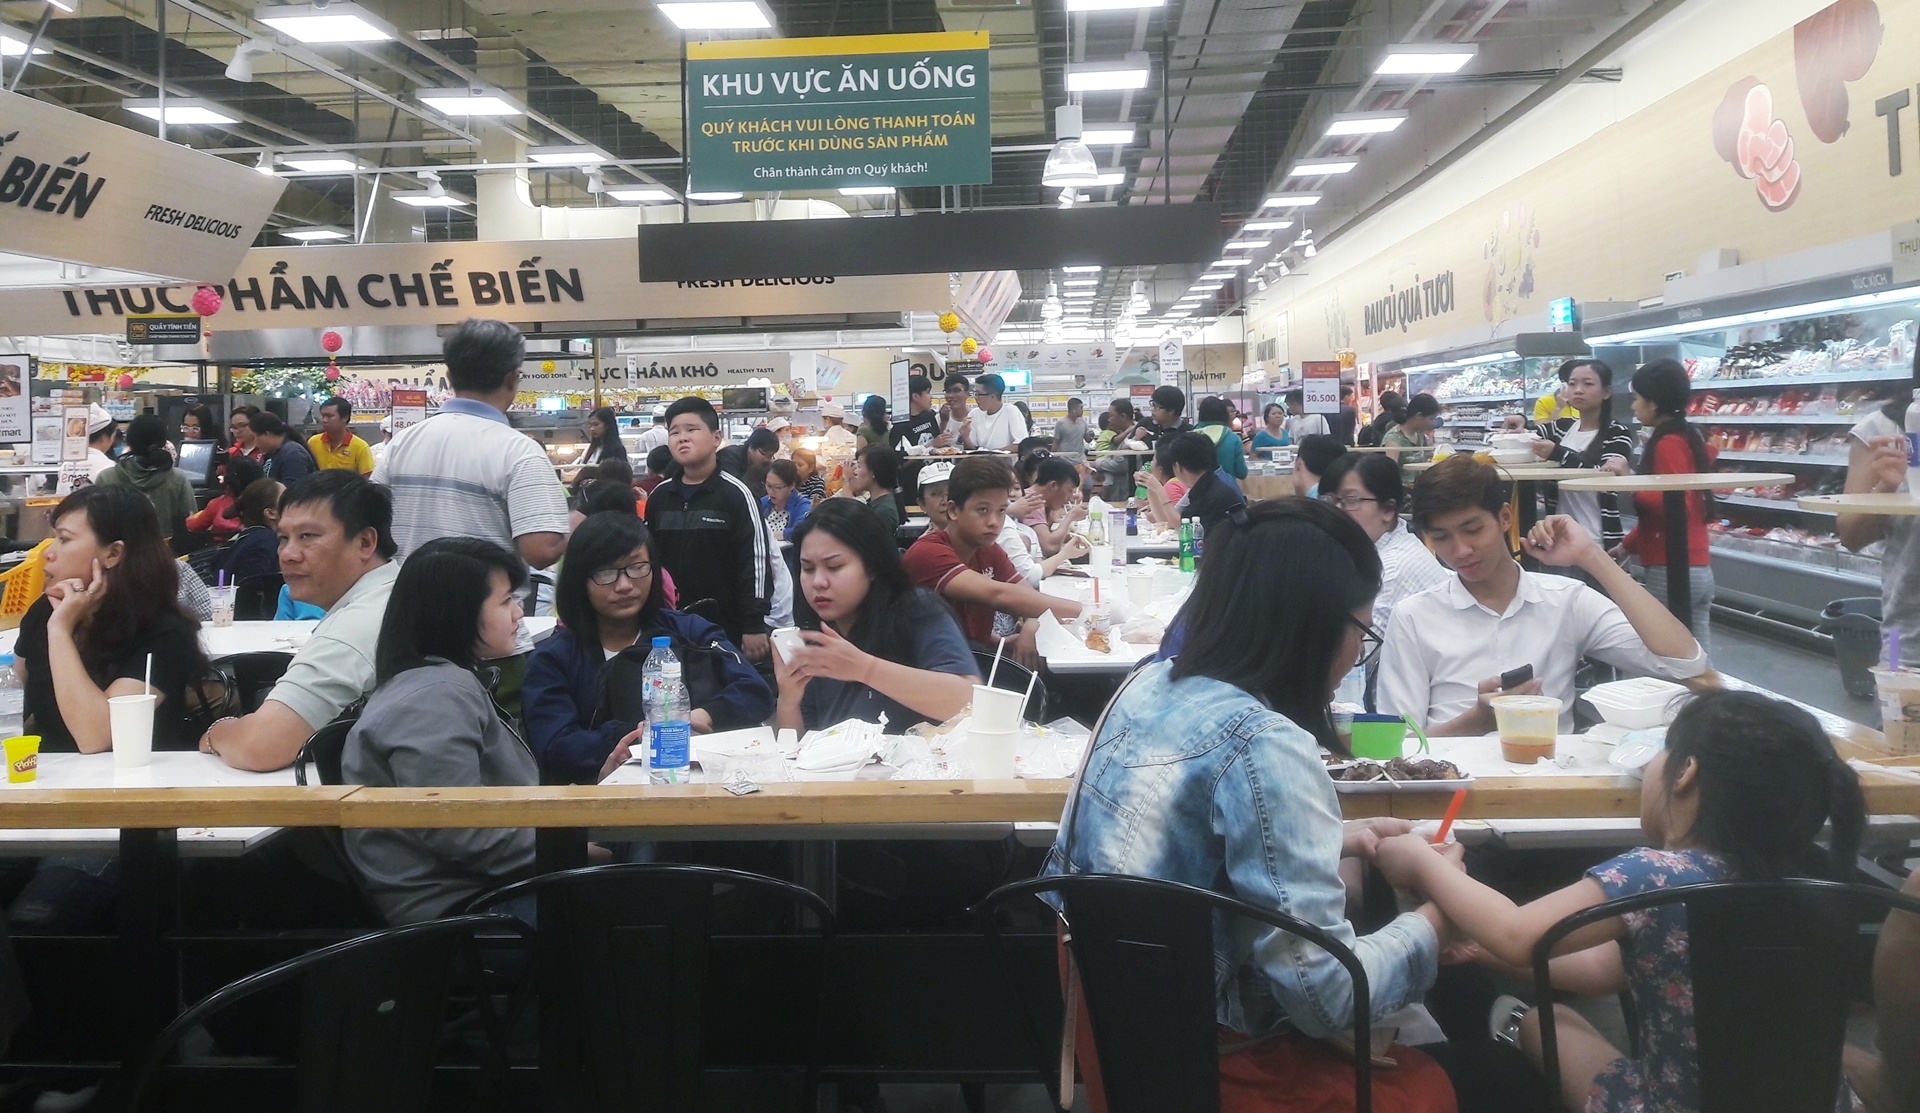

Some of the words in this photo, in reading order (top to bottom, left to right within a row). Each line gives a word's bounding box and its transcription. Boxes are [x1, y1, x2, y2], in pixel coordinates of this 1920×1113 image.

[702, 73, 763, 97] KHU
[771, 67, 831, 99] VỰC
[838, 63, 879, 92] ĂN
[887, 56, 976, 90] UỐNG
[701, 118, 735, 137] QUÝ
[738, 117, 792, 134] KHÁCH
[795, 118, 822, 132] VUI
[826, 115, 870, 131] LÒNG
[873, 114, 928, 129] THANH
[931, 110, 976, 127] TOÁN
[732, 136, 785, 153] TRƯỚC
[788, 139, 814, 151] KHI
[818, 134, 864, 150] DÙNG
[867, 133, 898, 149] SẢN
[902, 129, 948, 148] PHẨM
[1875, 83, 1920, 177] T
[0, 151, 106, 219] BIẾN
[753, 166, 783, 178] Chân
[785, 165, 818, 177] thành
[820, 163, 844, 176] cảm
[846, 165, 861, 175] ơn
[864, 162, 888, 177] Quý
[890, 161, 928, 174] khách!
[143, 203, 187, 226] FRESH
[183, 213, 242, 239] DELICIOUS
[357, 258, 459, 308] CHẾ
[468, 256, 584, 305] BIẾN
[1364, 299, 1383, 336] RAU
[1383, 283, 1397, 330] CỦ
[1398, 273, 1423, 333] QUẢ
[1422, 269, 1454, 318] TƯƠI
[681, 362, 719, 378] KHÔ
[1306, 394, 1336, 402] 30.500
